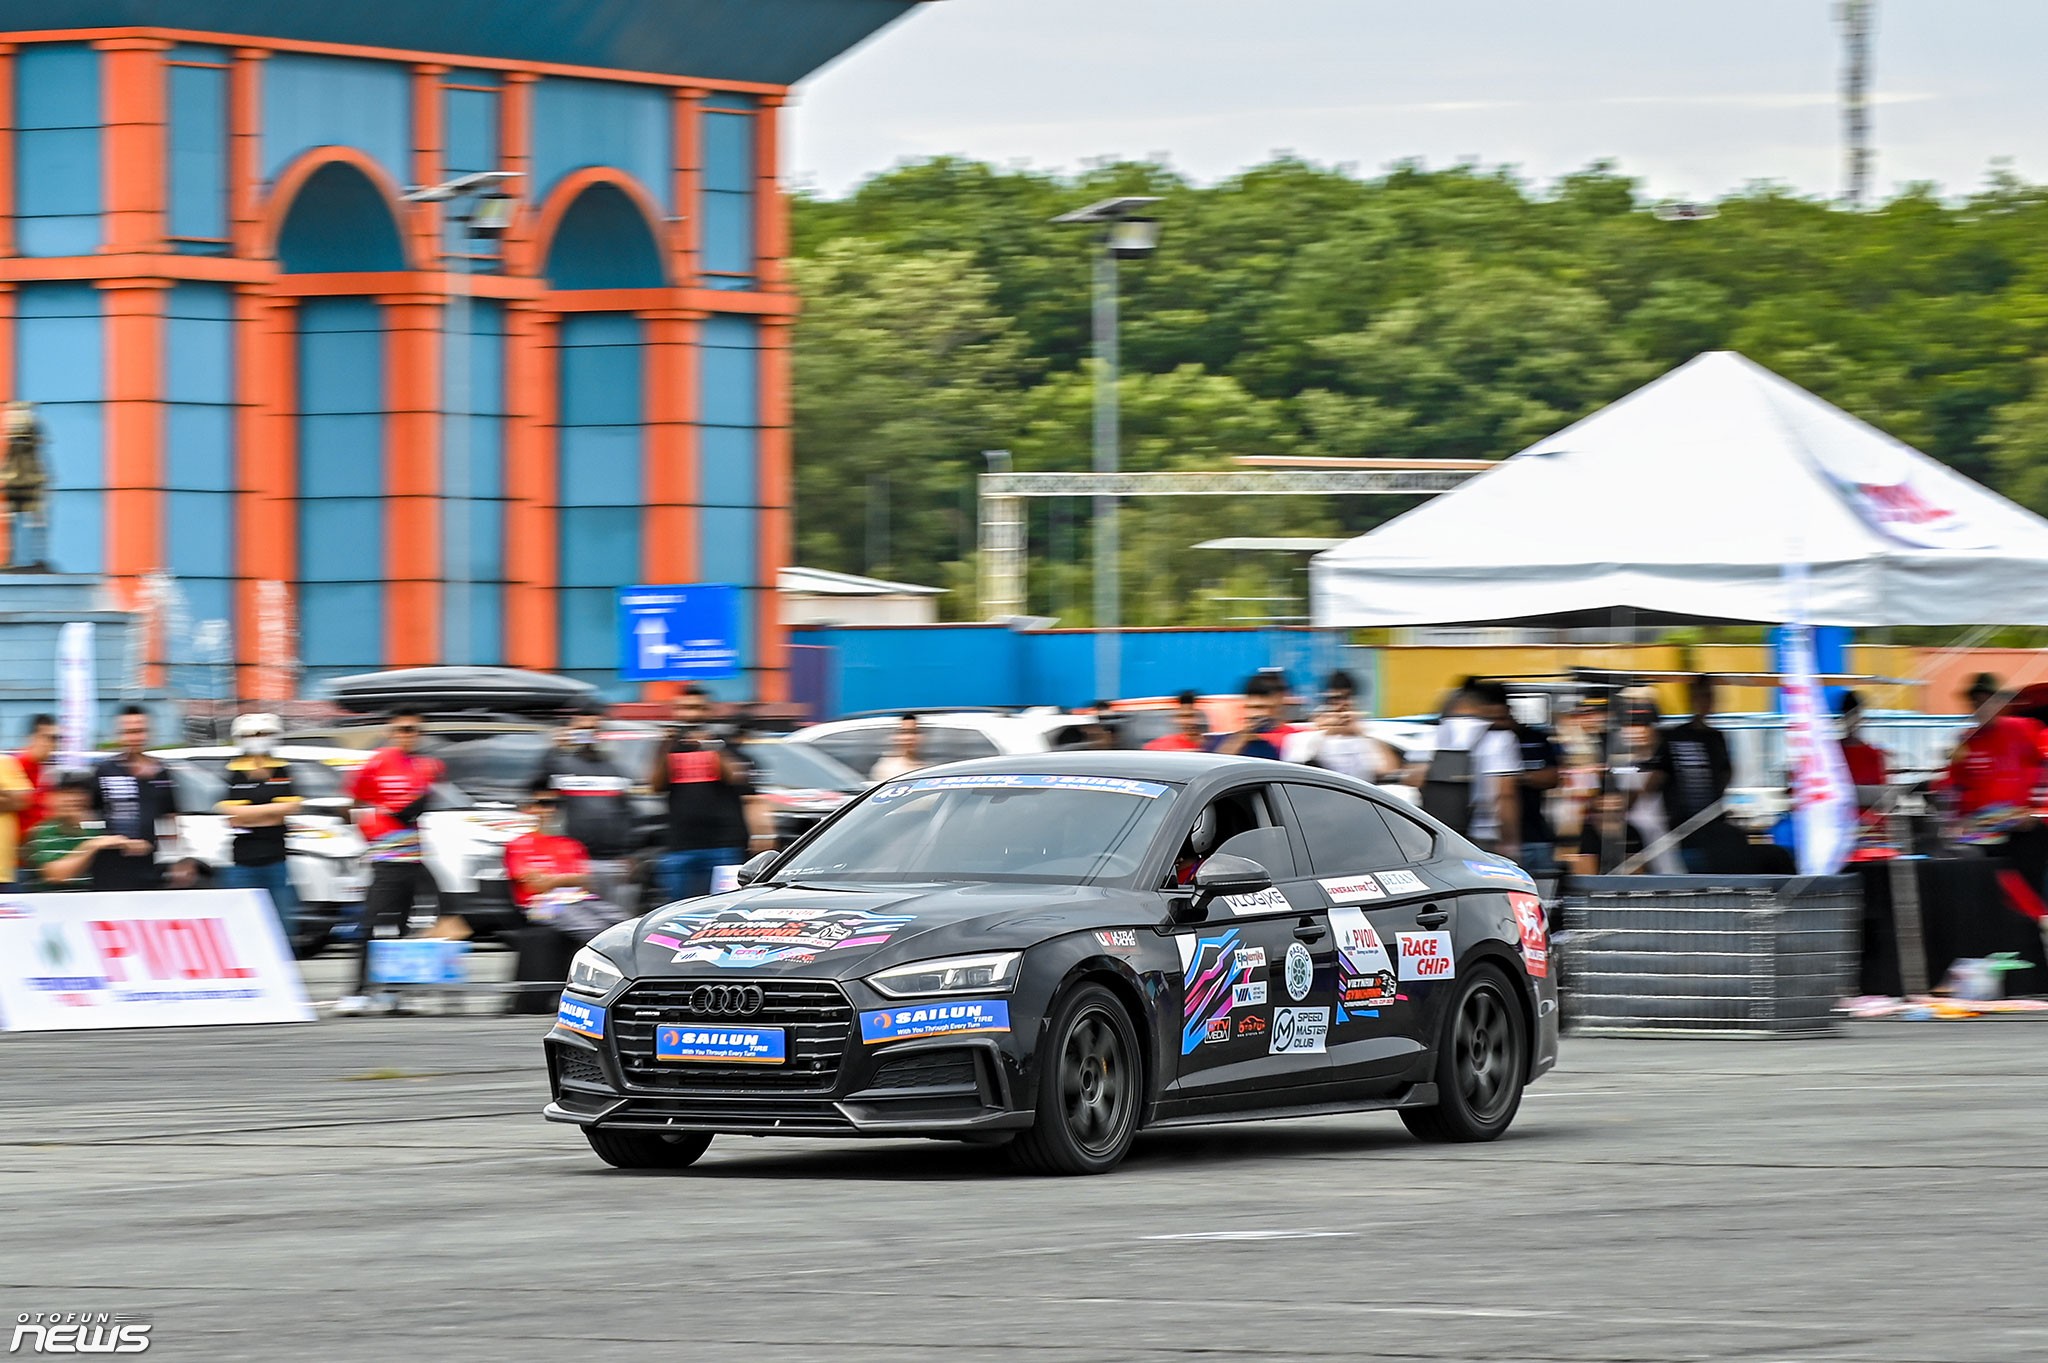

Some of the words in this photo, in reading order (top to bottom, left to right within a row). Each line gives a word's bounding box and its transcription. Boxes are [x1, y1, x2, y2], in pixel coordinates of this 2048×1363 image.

[702, 921, 785, 931] VIETNAM
[690, 928, 801, 940] GYMKHANA
[1353, 928, 1378, 948] PVOIL
[1289, 945, 1309, 961] PASSIO
[1401, 937, 1437, 957] RACE
[1417, 957, 1450, 975] CHIP
[1288, 981, 1308, 998] TUNING
[895, 1005, 982, 1024] SAILUN
[1297, 1012, 1323, 1021] SPEED
[925, 1023, 950, 1032] Through
[950, 1023, 967, 1031] Every
[1296, 1025, 1327, 1035] MASTER
[682, 1032, 758, 1045] SAILUN
[1294, 1038, 1315, 1047] CLUB
[706, 1049, 728, 1057] Through
